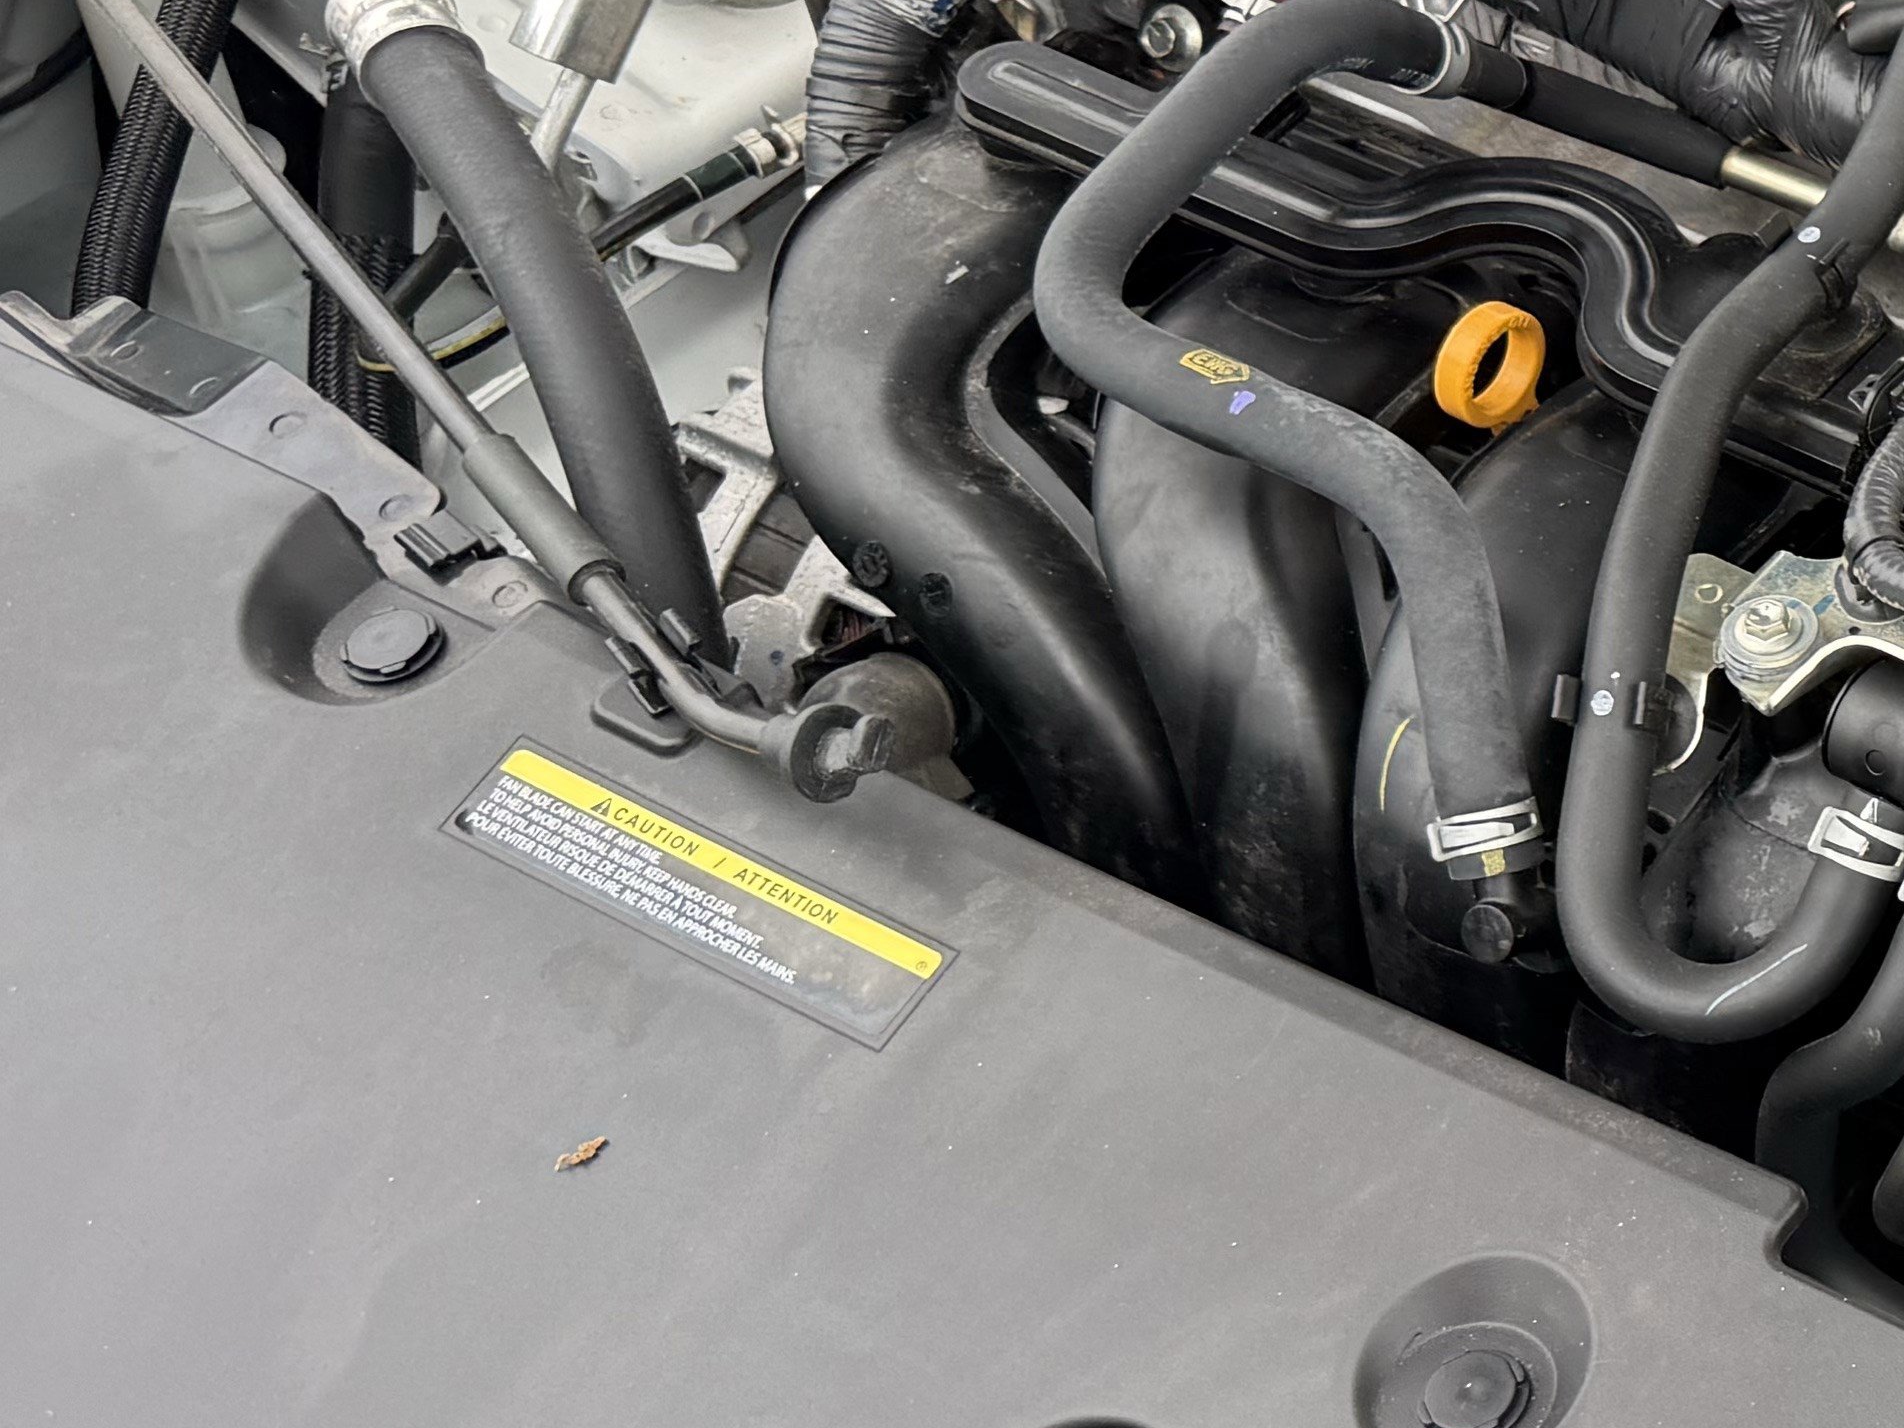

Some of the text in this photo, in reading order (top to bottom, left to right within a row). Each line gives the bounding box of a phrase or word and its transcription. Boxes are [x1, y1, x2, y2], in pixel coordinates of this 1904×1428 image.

[477, 800, 498, 816] LE
[490, 806, 564, 849] VENTILATEUR
[557, 840, 602, 869] RISQUE
[596, 859, 620, 877] DE
[680, 901, 717, 925] TOUT
[489, 789, 509, 804] TO
[502, 795, 535, 817] HELP
[527, 807, 565, 832] AVOID
[558, 823, 614, 857] PERSONAL
[642, 865, 672, 885] KEEP
[667, 877, 708, 903] HANDS
[498, 776, 523, 794] FAN
[518, 786, 555, 810] BLADE
[549, 801, 577, 821] CAN
[571, 812, 606, 835] START
[600, 826, 620, 842] AT
[613, 833, 643, 853] ANY
[612, 806, 700, 858] CAUTION
[733, 864, 839, 927] ATTENTION
[464, 811, 503, 836] POUR
[531, 845, 573, 871] TOUTE
[619, 888, 644, 907] NE
[635, 896, 663, 916] PAS
[655, 906, 679, 924] EN
[671, 914, 745, 958] APPROCHER
[736, 946, 761, 965] LES
